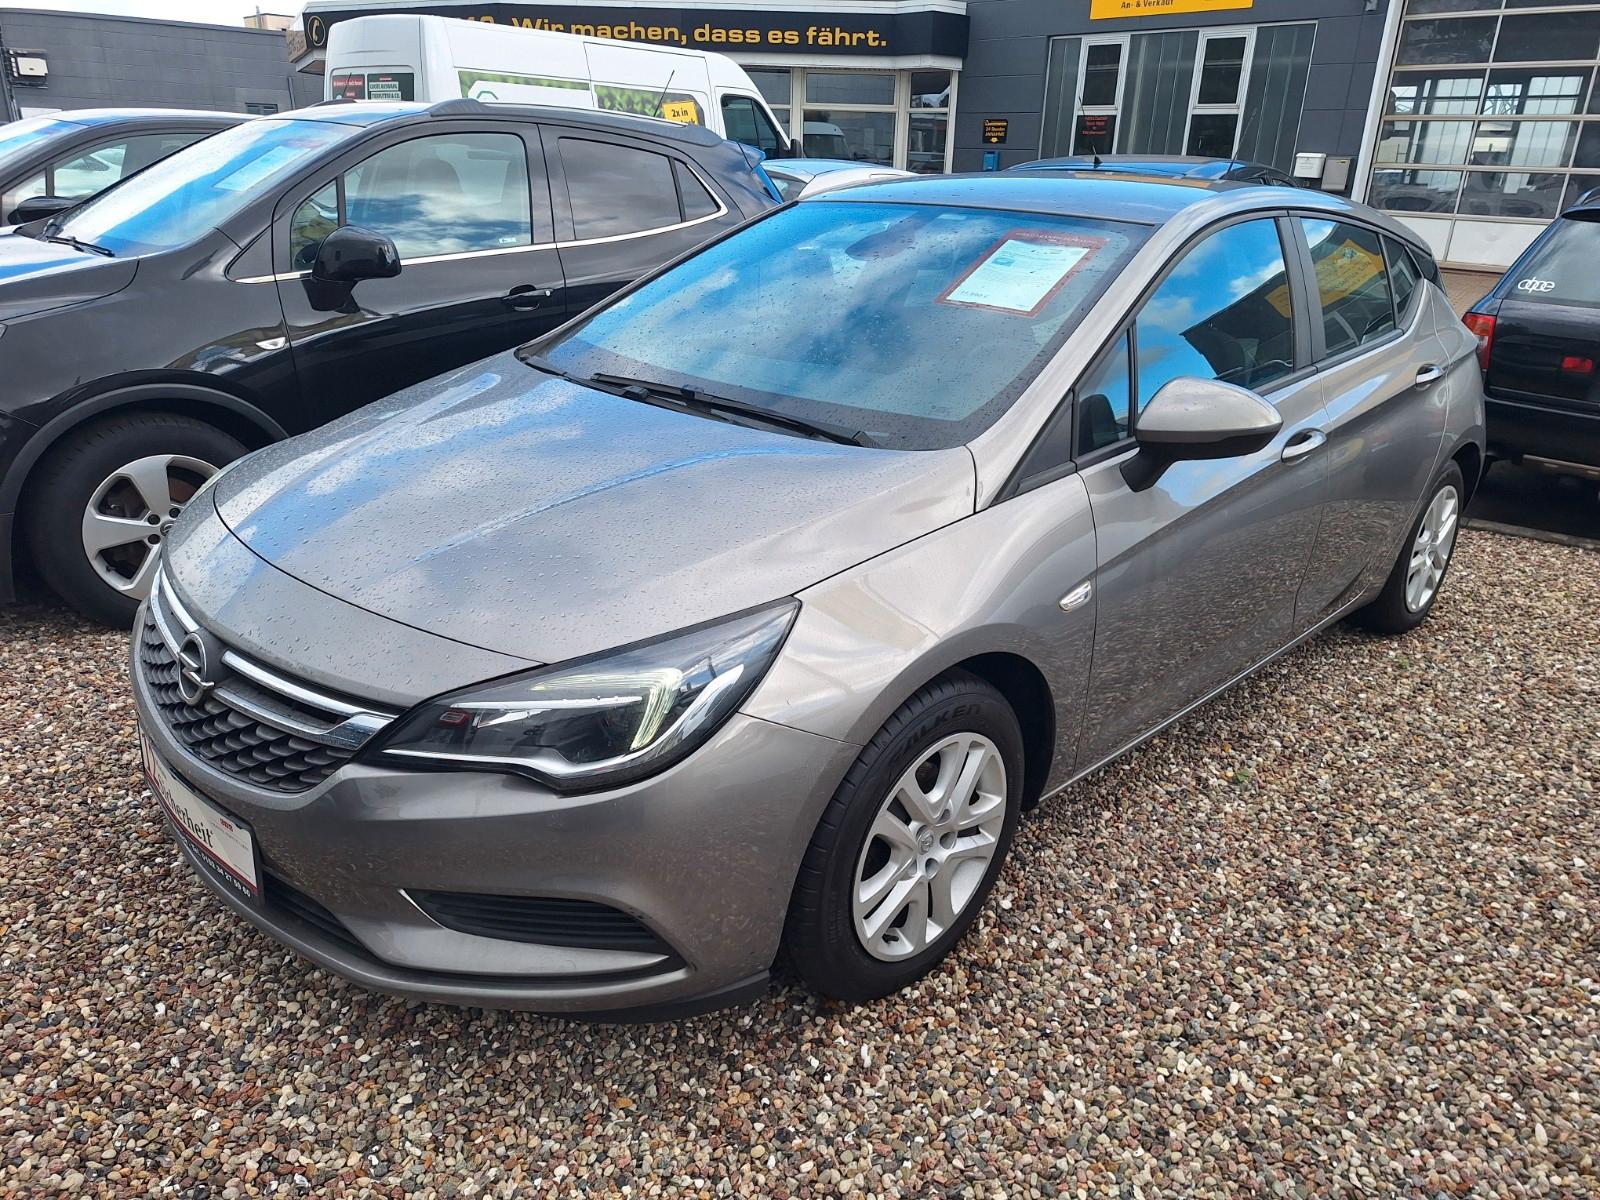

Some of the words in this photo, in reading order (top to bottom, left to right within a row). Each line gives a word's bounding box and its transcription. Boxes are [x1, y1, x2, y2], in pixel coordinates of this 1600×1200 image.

[511, 17, 564, 32] Wir
[570, 21, 687, 45] machen,
[693, 24, 761, 44] dass
[767, 29, 800, 45] es
[806, 26, 887, 47] fährt.
[681, 107, 689, 117] in
